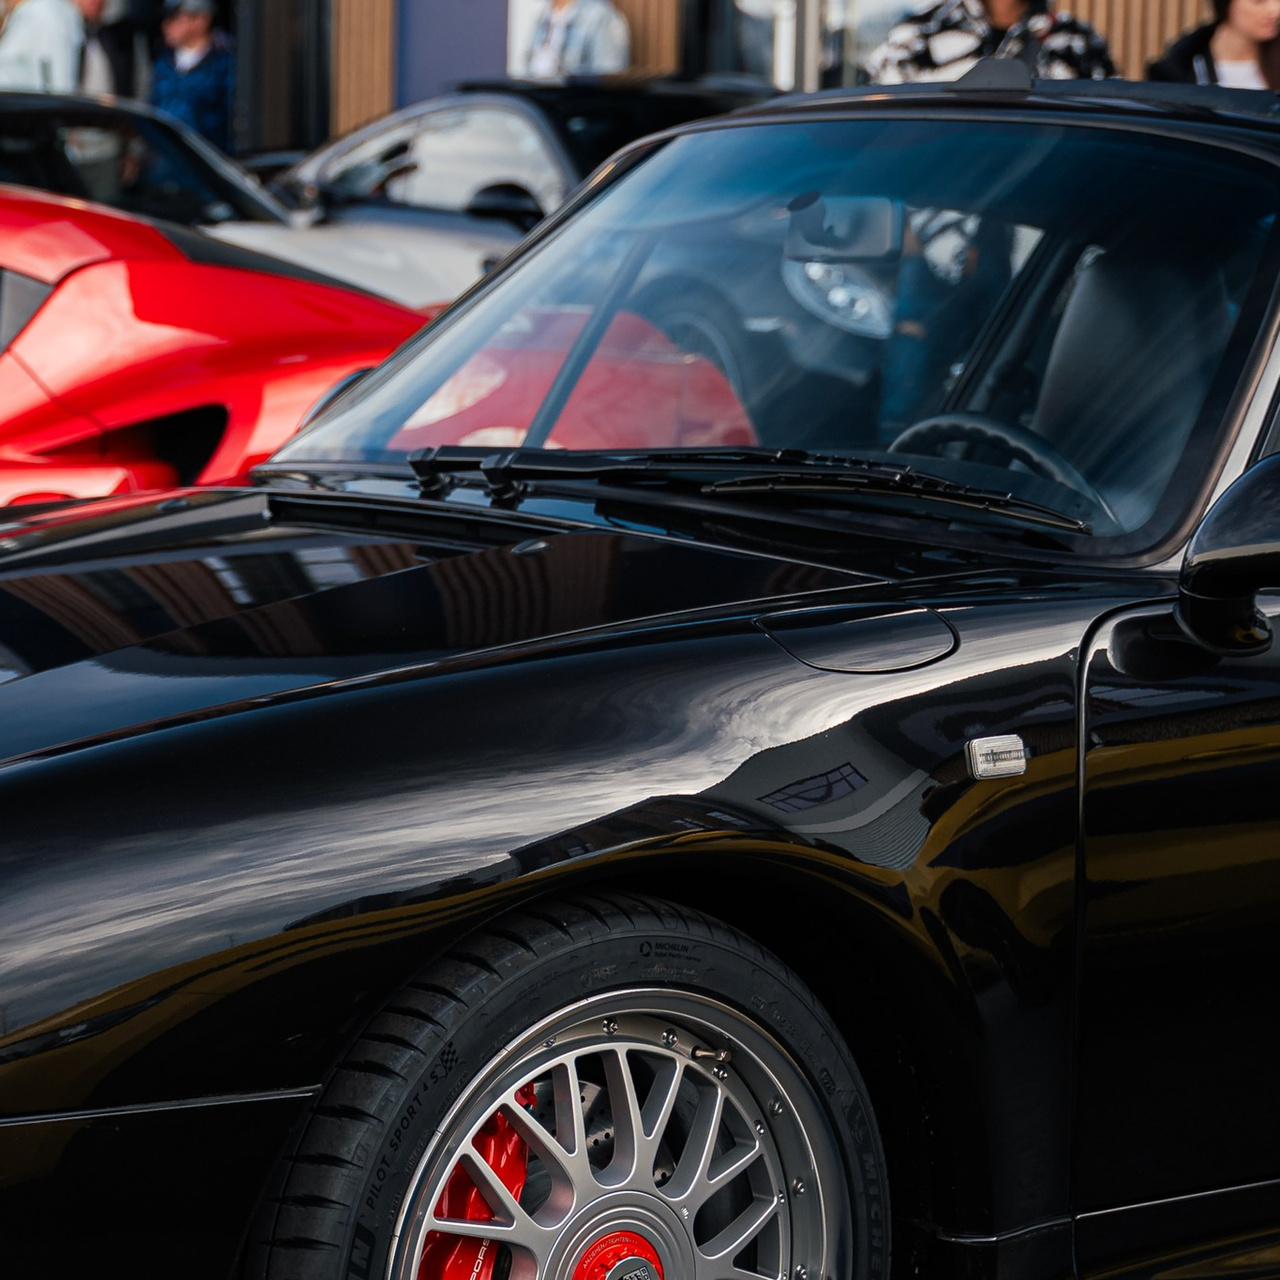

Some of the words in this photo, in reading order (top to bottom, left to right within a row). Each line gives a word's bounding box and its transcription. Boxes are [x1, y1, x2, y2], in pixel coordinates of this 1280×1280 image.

[655, 942, 688, 953] MICHELIN
[366, 1156, 391, 1210] PILOT
[389, 1094, 423, 1152] SPORT
[430, 1071, 439, 1084] S
